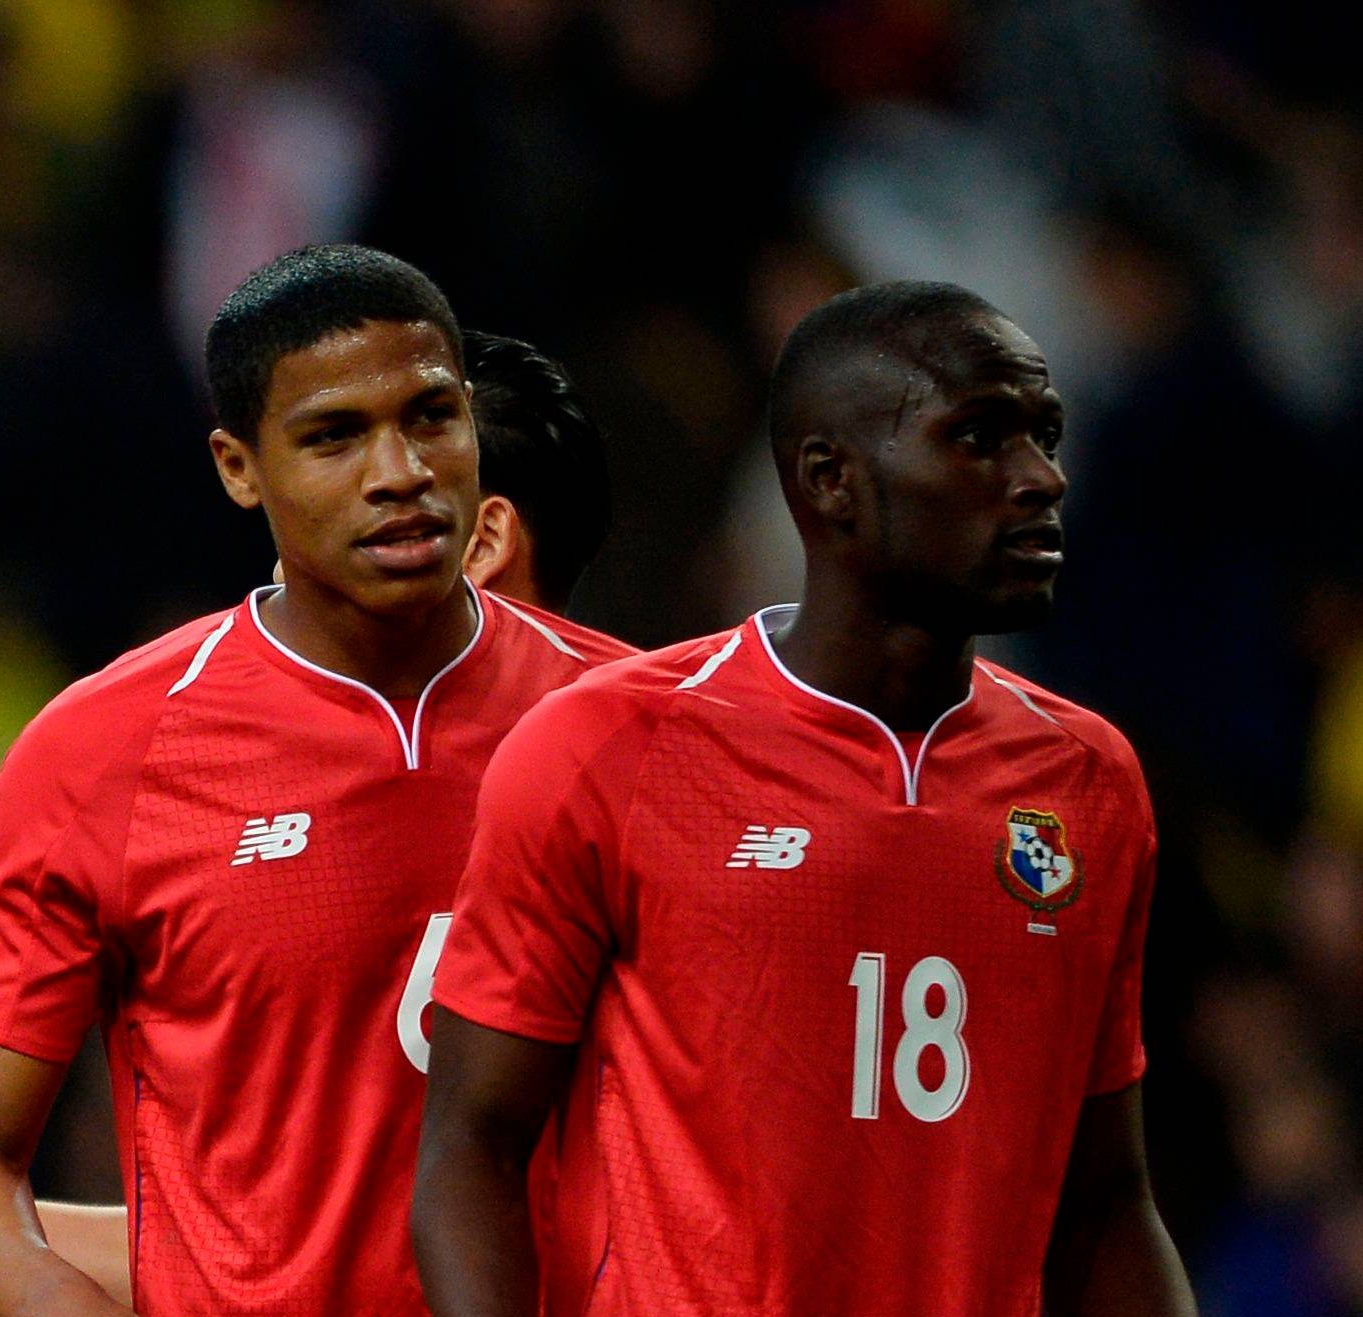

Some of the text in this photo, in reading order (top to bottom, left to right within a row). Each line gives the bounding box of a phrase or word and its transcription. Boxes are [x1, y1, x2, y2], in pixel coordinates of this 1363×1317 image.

[230, 812, 311, 867] NB
[725, 824, 812, 870] NB
[847, 951, 971, 1122] 18
